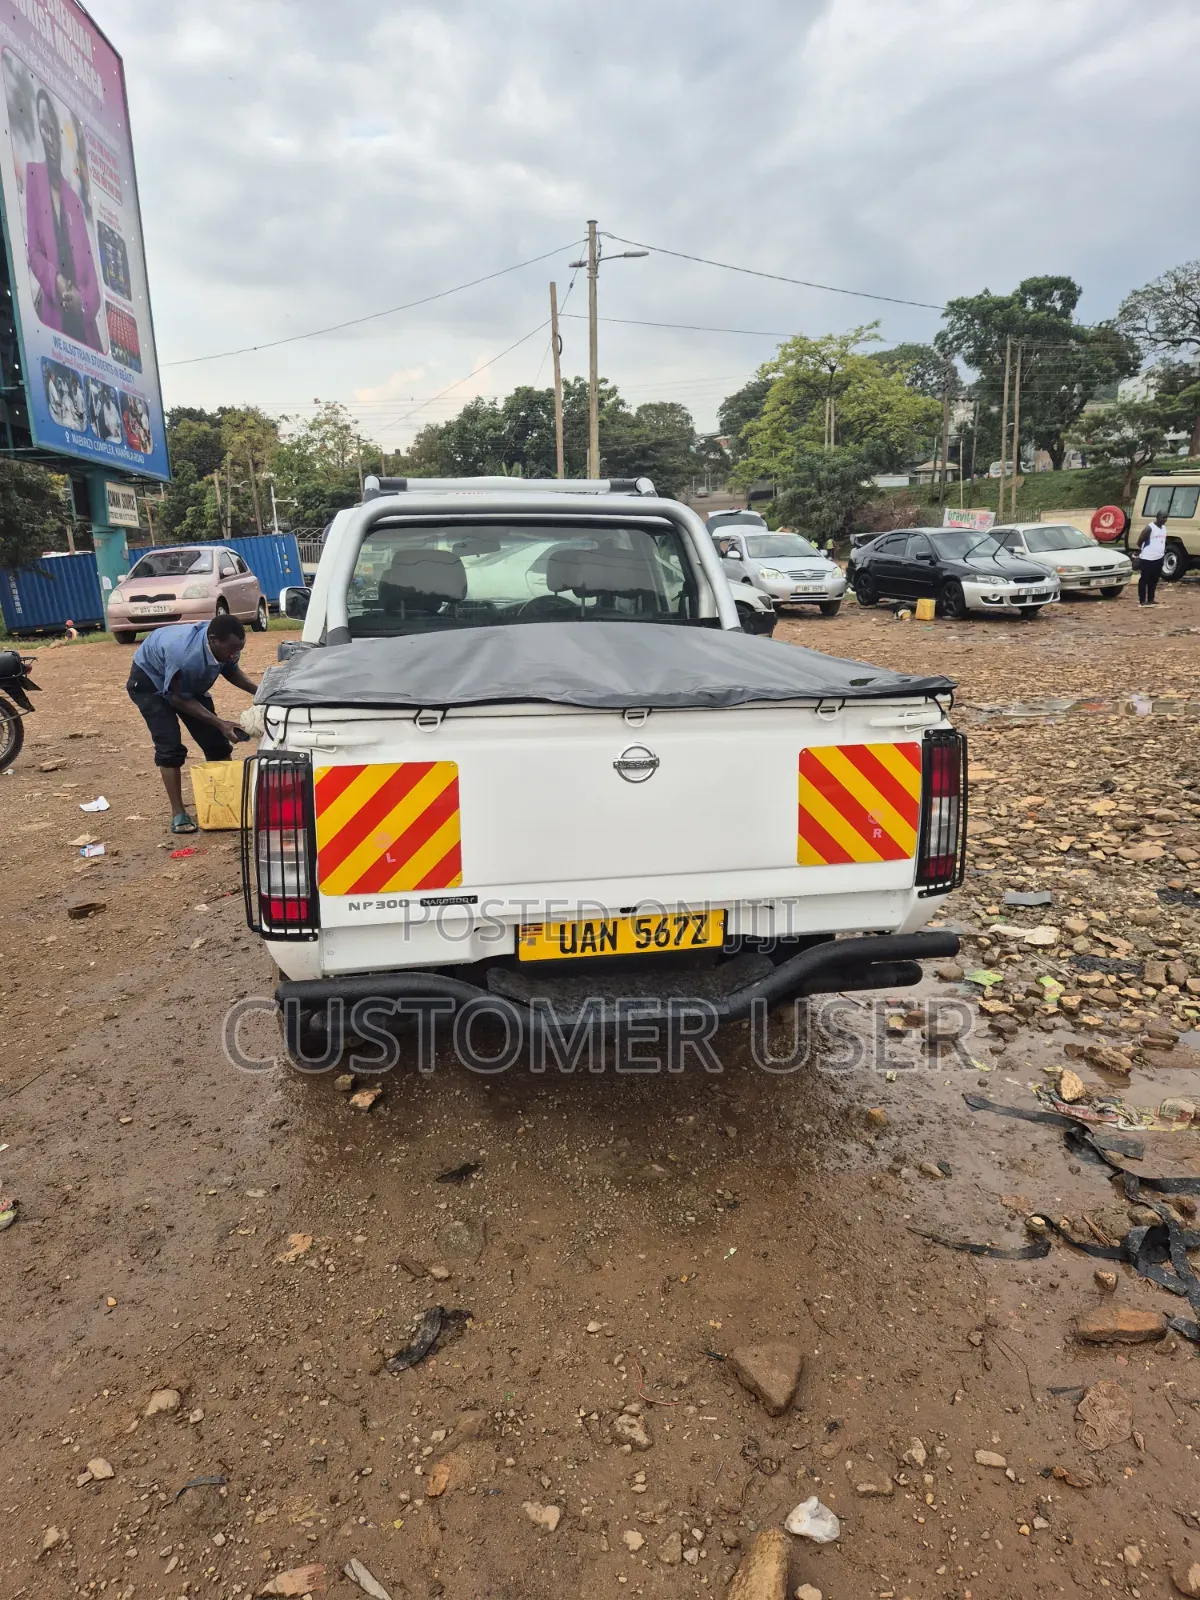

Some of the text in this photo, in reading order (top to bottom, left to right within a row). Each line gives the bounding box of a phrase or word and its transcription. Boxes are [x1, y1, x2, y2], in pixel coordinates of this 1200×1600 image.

[614, 759, 660, 769] NISSAN
[873, 828, 882, 838] R
[386, 852, 396, 863] L
[348, 899, 410, 911] NP300
[559, 914, 708, 954] UAN 567Z
